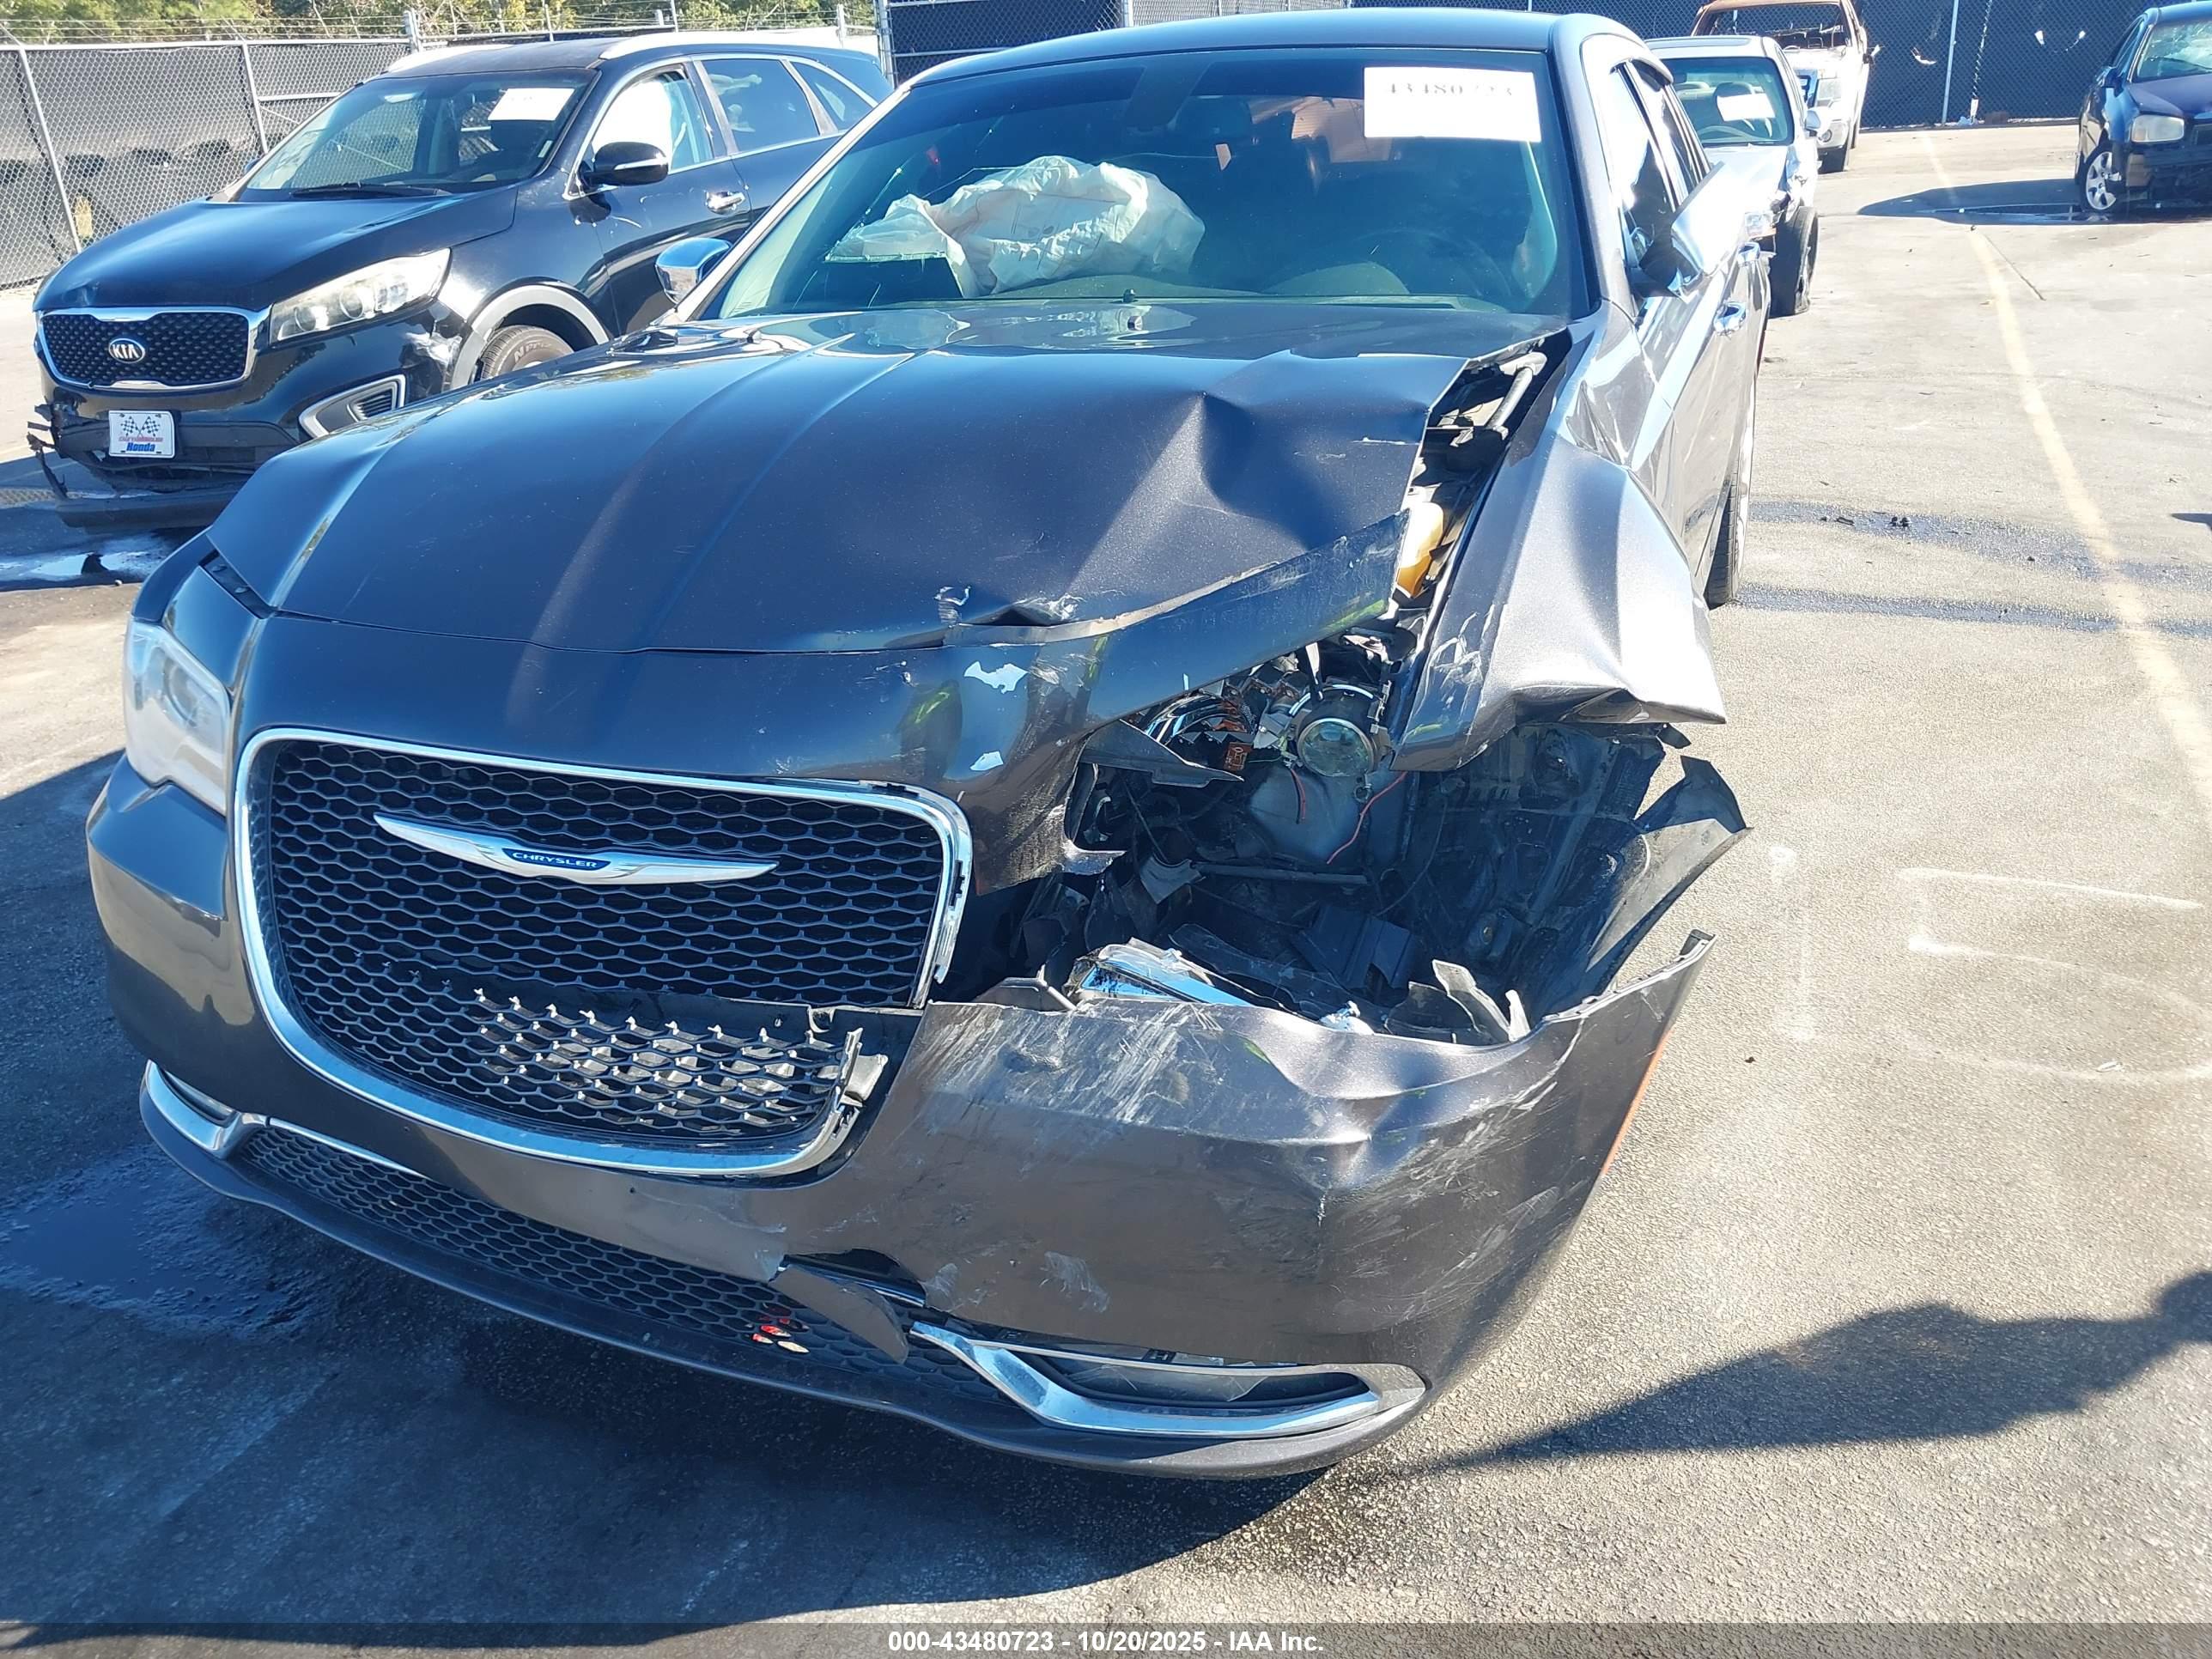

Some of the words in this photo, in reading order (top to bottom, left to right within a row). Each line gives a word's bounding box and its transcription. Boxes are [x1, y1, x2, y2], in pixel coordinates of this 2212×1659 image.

[112, 343, 140, 359] KIA
[126, 442, 156, 452] Honda
[512, 852, 598, 868] CHRYSLER
